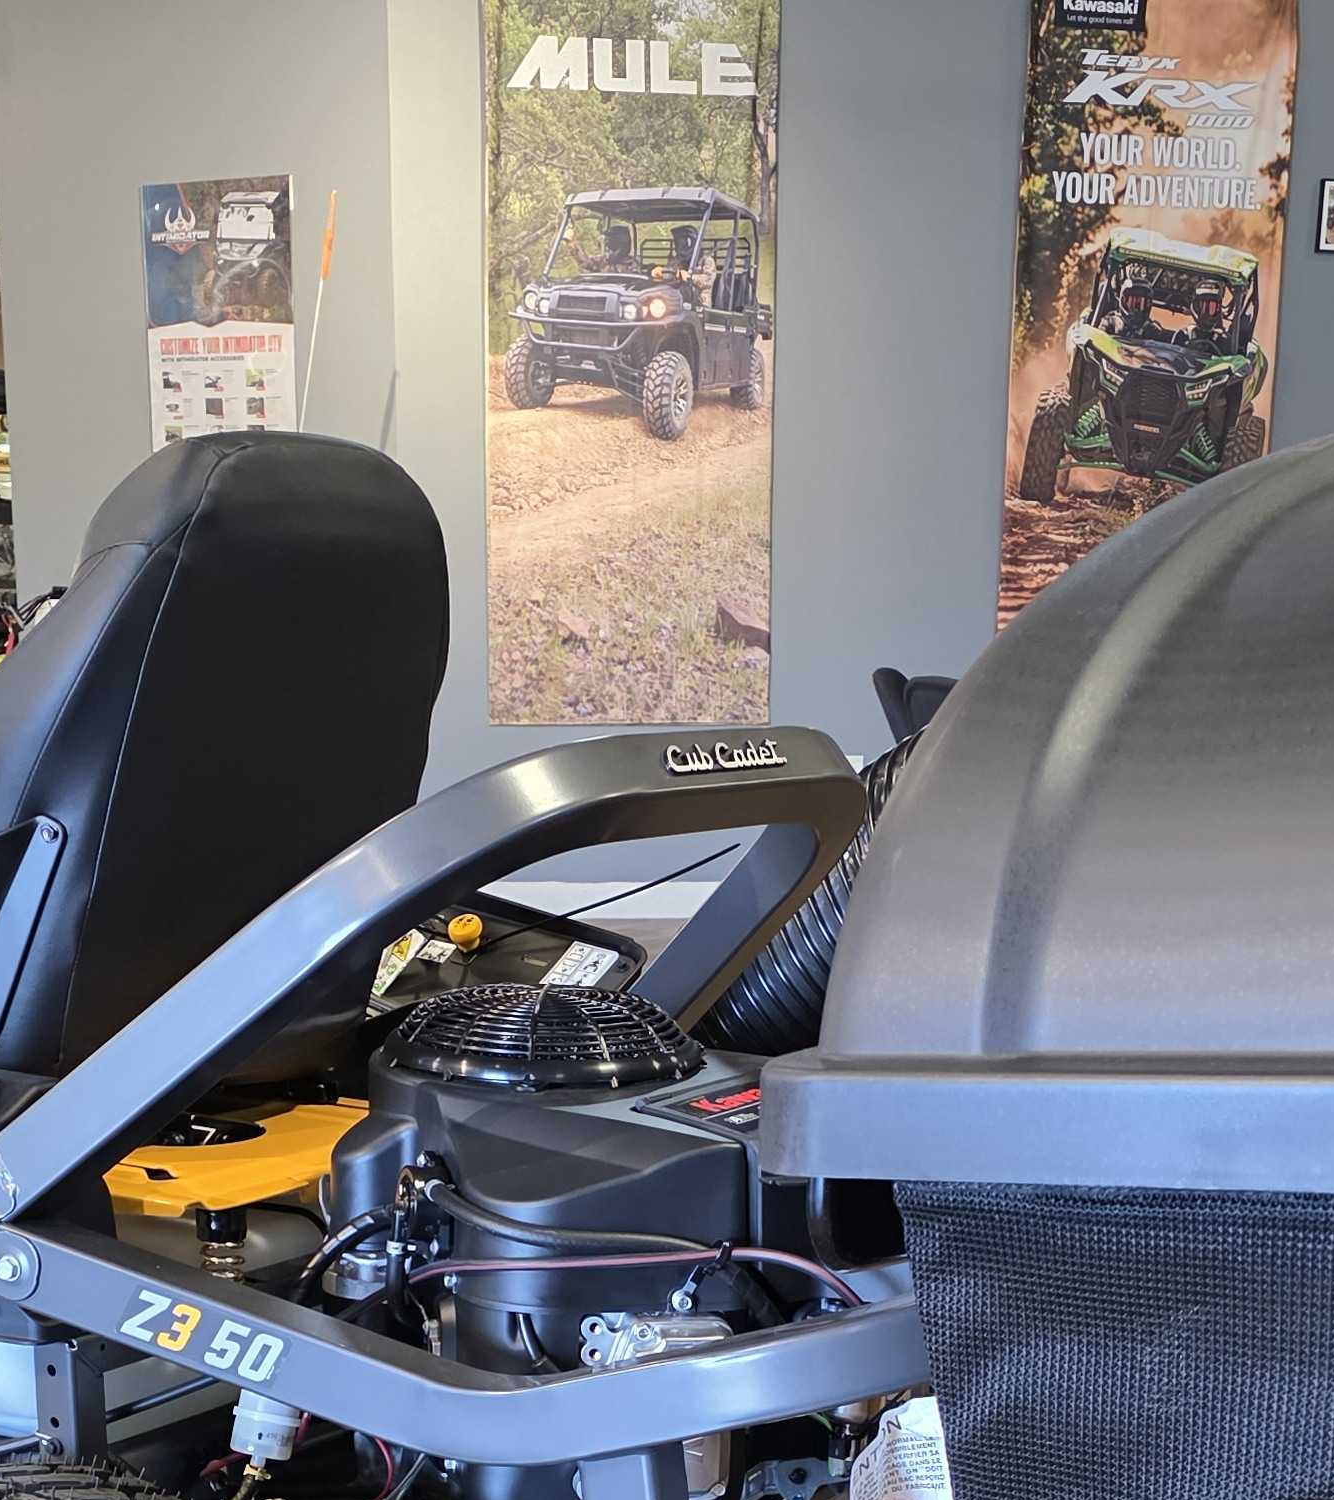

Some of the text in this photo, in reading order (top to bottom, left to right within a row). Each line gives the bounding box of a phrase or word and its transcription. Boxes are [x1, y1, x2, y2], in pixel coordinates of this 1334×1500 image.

[506, 35, 759, 96] MULE
[1063, 69, 1259, 110] KRX
[1187, 113, 1255, 129] 1000
[1080, 132, 1242, 171] YOUR WORLD.
[1052, 171, 1262, 210] YOUR ADVENTURE.
[667, 743, 714, 773] Cub
[119, 1289, 284, 1382] Z3 50
